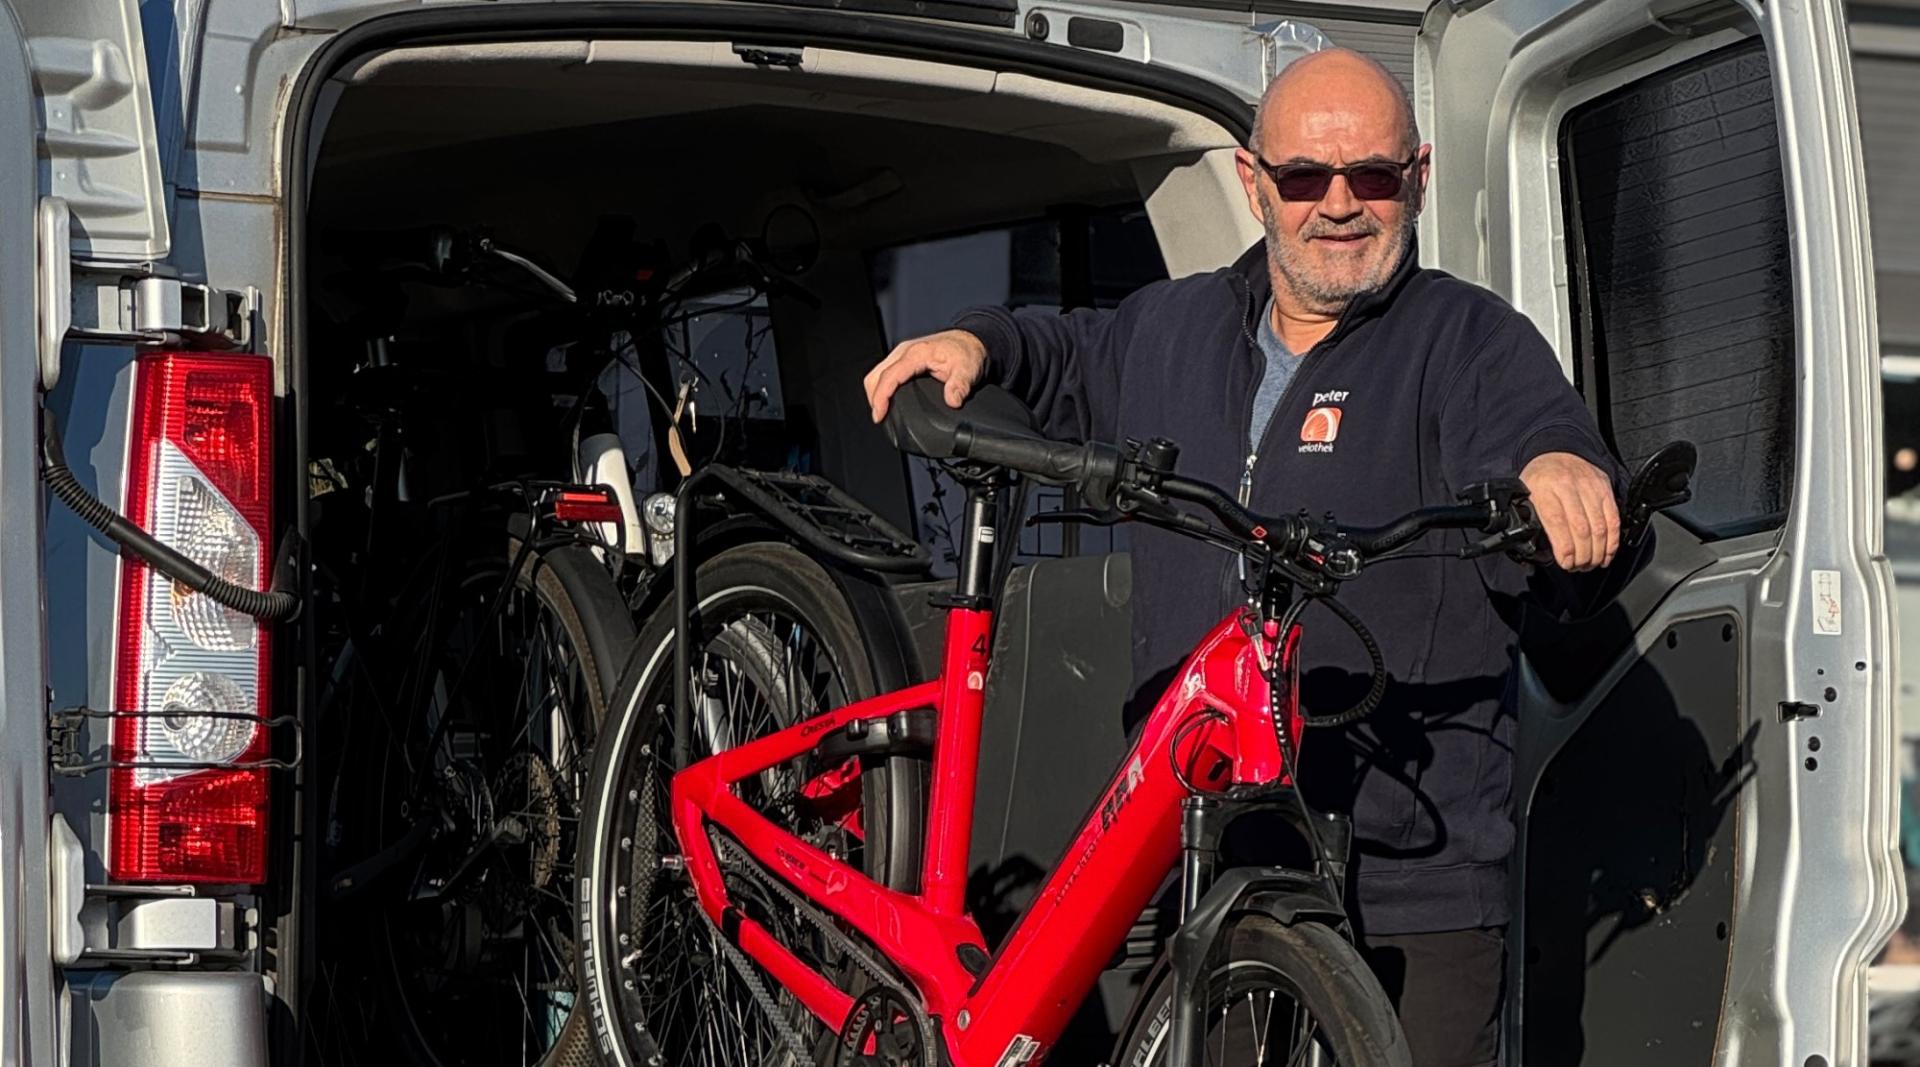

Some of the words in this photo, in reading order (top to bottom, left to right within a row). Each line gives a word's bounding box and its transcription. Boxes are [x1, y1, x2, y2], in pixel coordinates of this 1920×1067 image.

[1312, 390, 1349, 407] peter
[1298, 442, 1334, 453] velothek
[972, 634, 986, 656] 4
[581, 900, 614, 1056] SCHWALBE
[1132, 1004, 1170, 1067] ALBE
